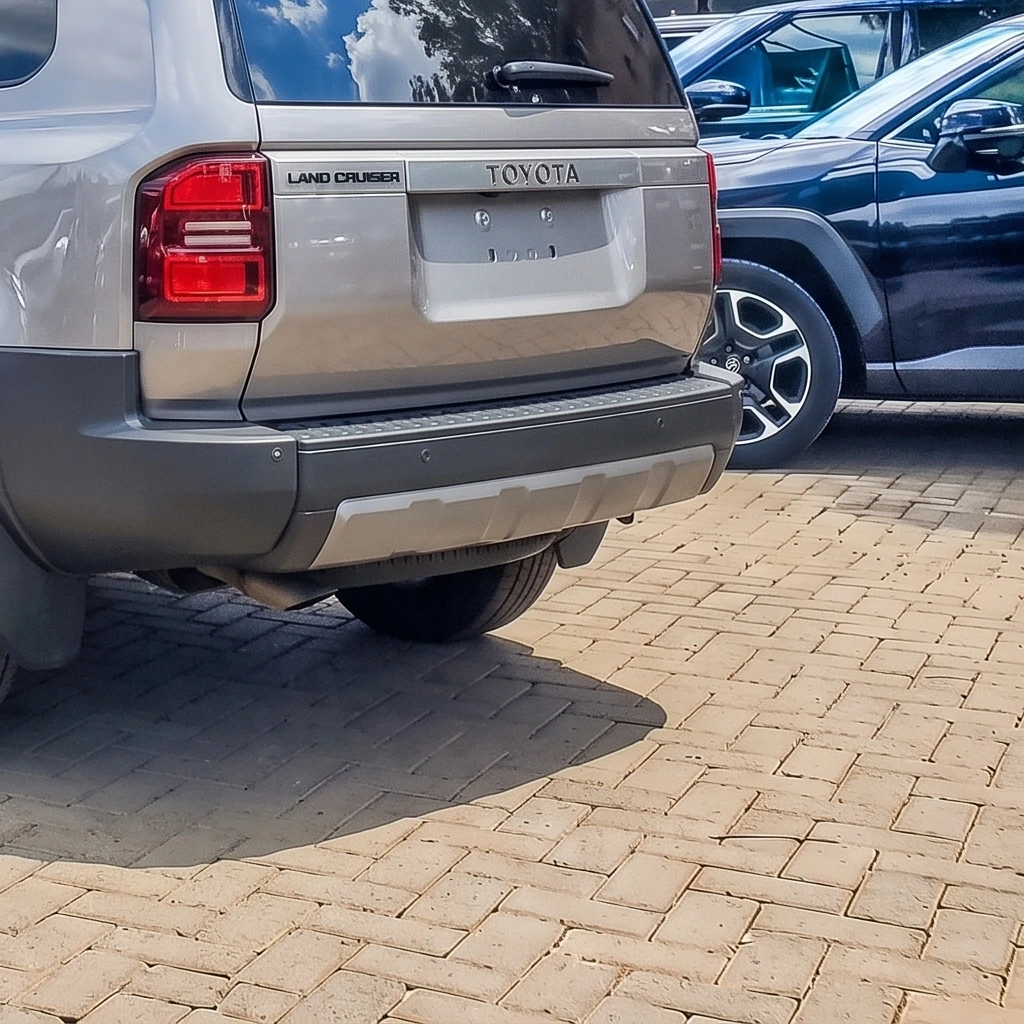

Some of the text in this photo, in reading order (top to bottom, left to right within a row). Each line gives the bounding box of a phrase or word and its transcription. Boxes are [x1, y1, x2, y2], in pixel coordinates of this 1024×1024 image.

[287, 171, 401, 185] LAND CRUISER
[485, 163, 581, 186] TOYOTA
